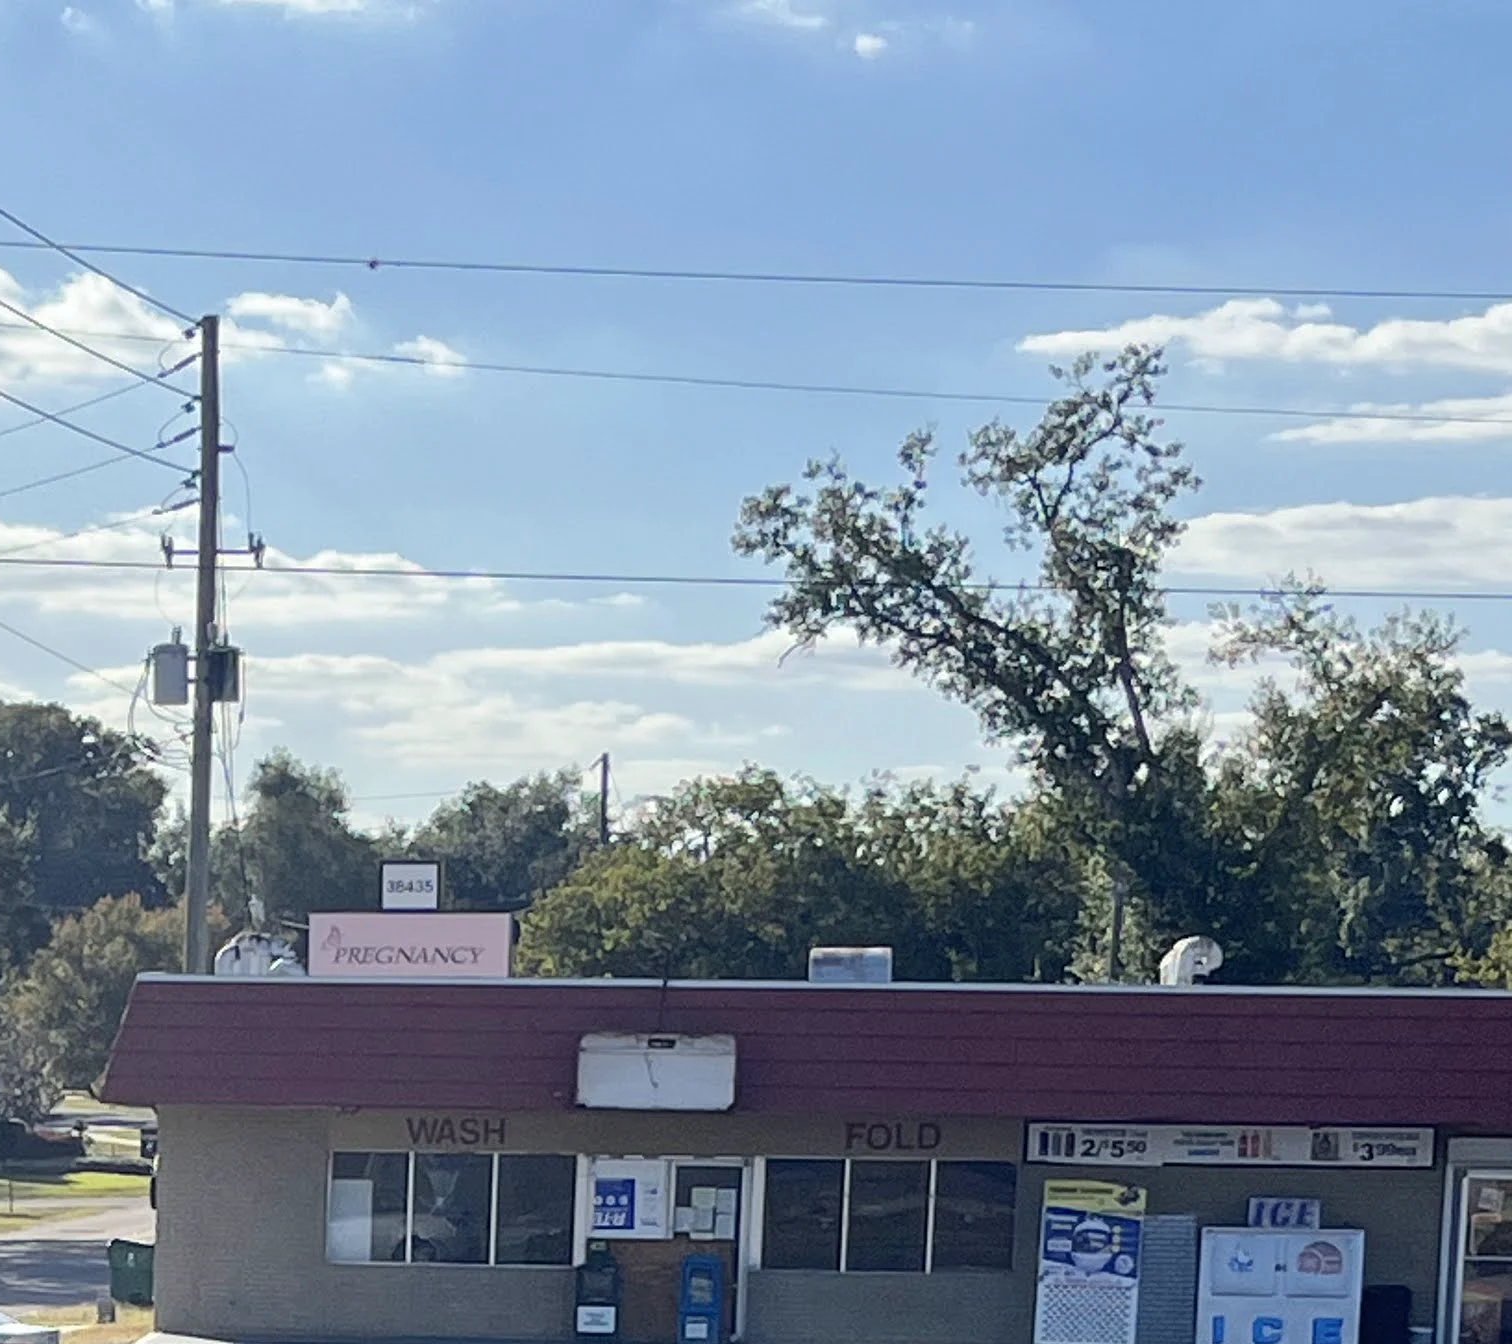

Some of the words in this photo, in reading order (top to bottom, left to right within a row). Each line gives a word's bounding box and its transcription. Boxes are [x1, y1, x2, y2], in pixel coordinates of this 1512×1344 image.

[387, 880, 434, 893] 38435
[333, 946, 484, 966] PREGNANCY
[406, 1117, 506, 1145] WASH
[845, 1122, 941, 1150] FOLD
[1252, 1201, 1317, 1228] ICE
